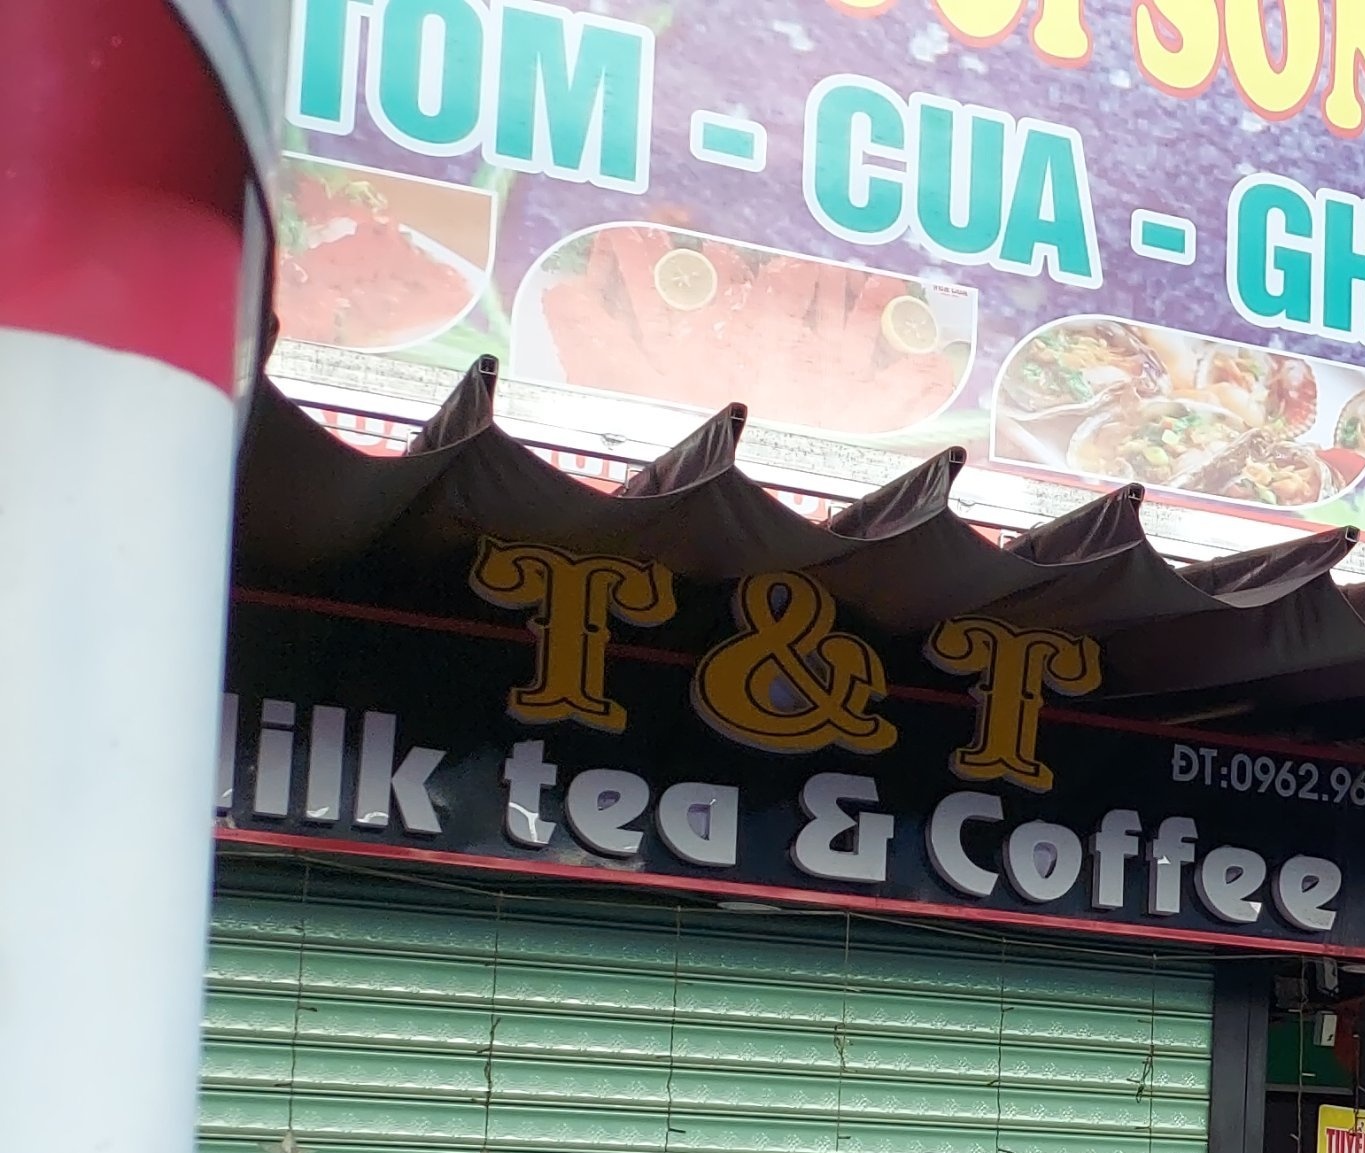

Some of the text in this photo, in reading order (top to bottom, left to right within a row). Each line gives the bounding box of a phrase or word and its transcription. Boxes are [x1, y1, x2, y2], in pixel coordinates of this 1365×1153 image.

[808, 78, 1098, 285] CUA
[221, 690, 1343, 932] ilk tea & Coffee
